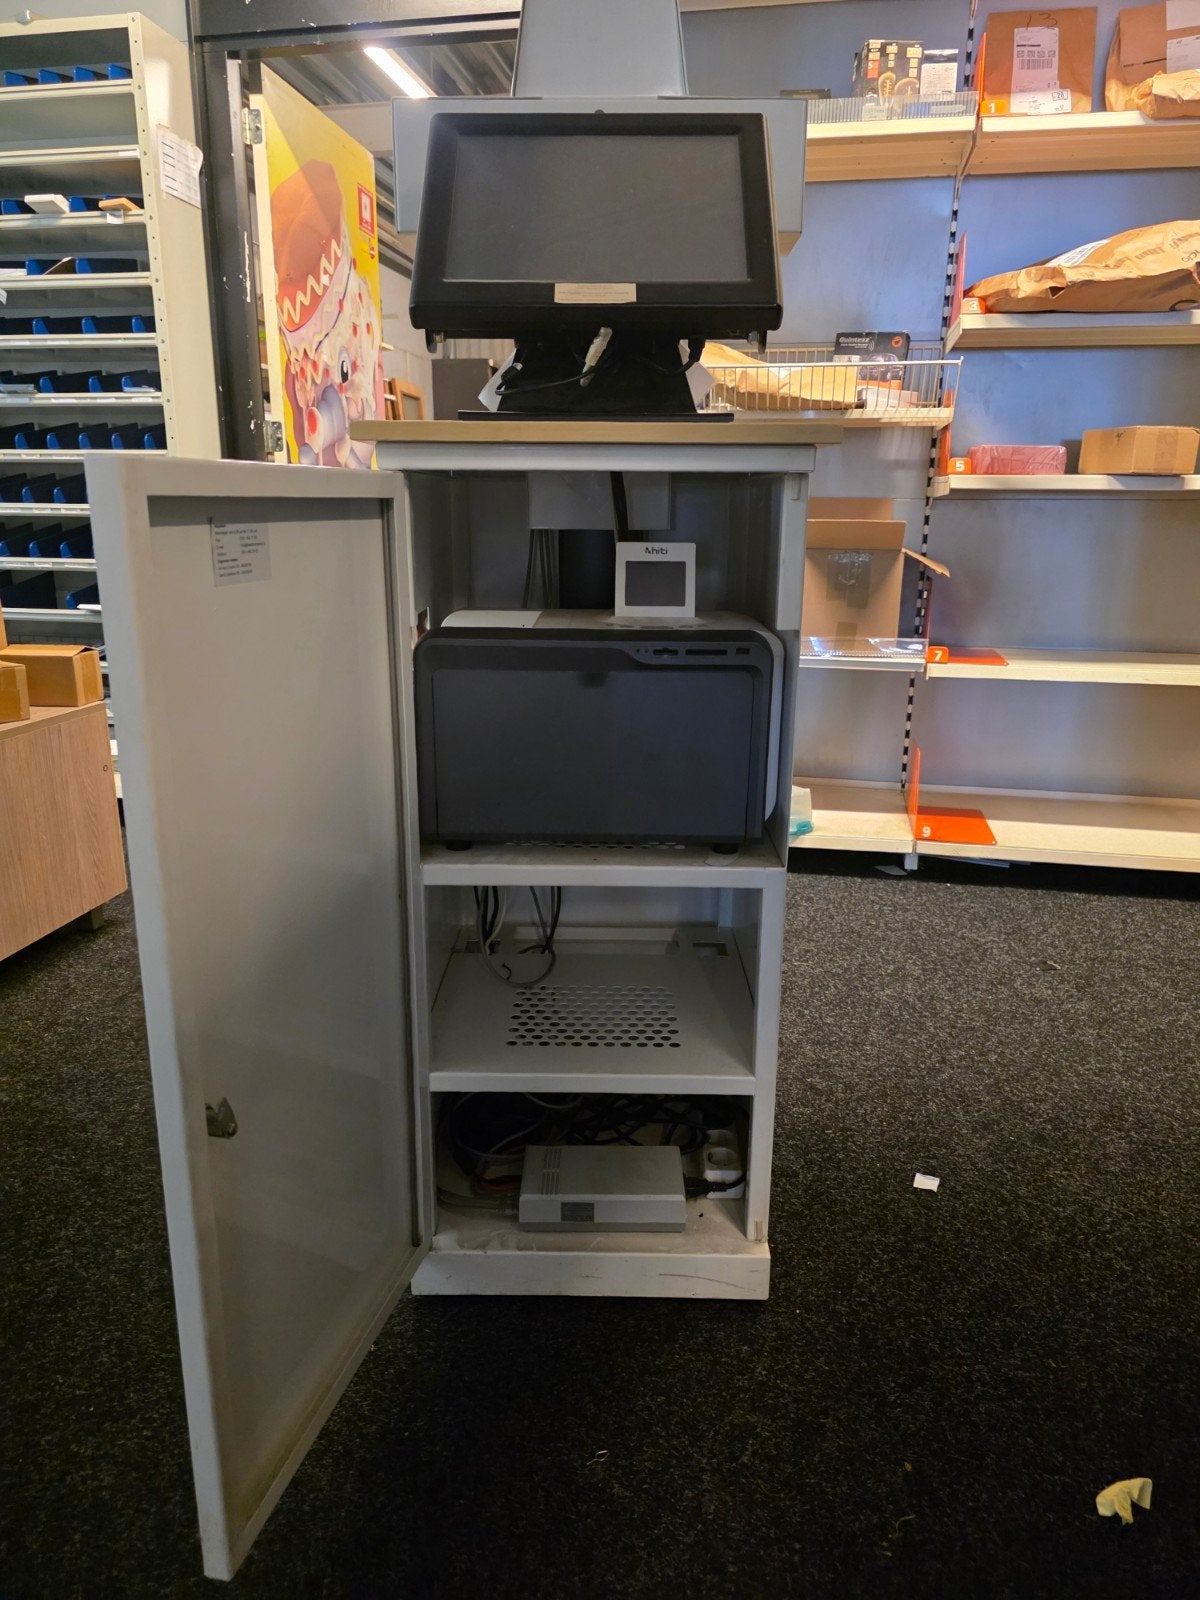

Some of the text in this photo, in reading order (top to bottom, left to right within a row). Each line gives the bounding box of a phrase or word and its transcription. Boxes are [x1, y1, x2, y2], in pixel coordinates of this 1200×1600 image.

[988, 102, 996, 114] 1
[968, 300, 978, 311] 3
[955, 460, 965, 472] 5
[934, 650, 943, 661] 7
[922, 826, 931, 838] 9
